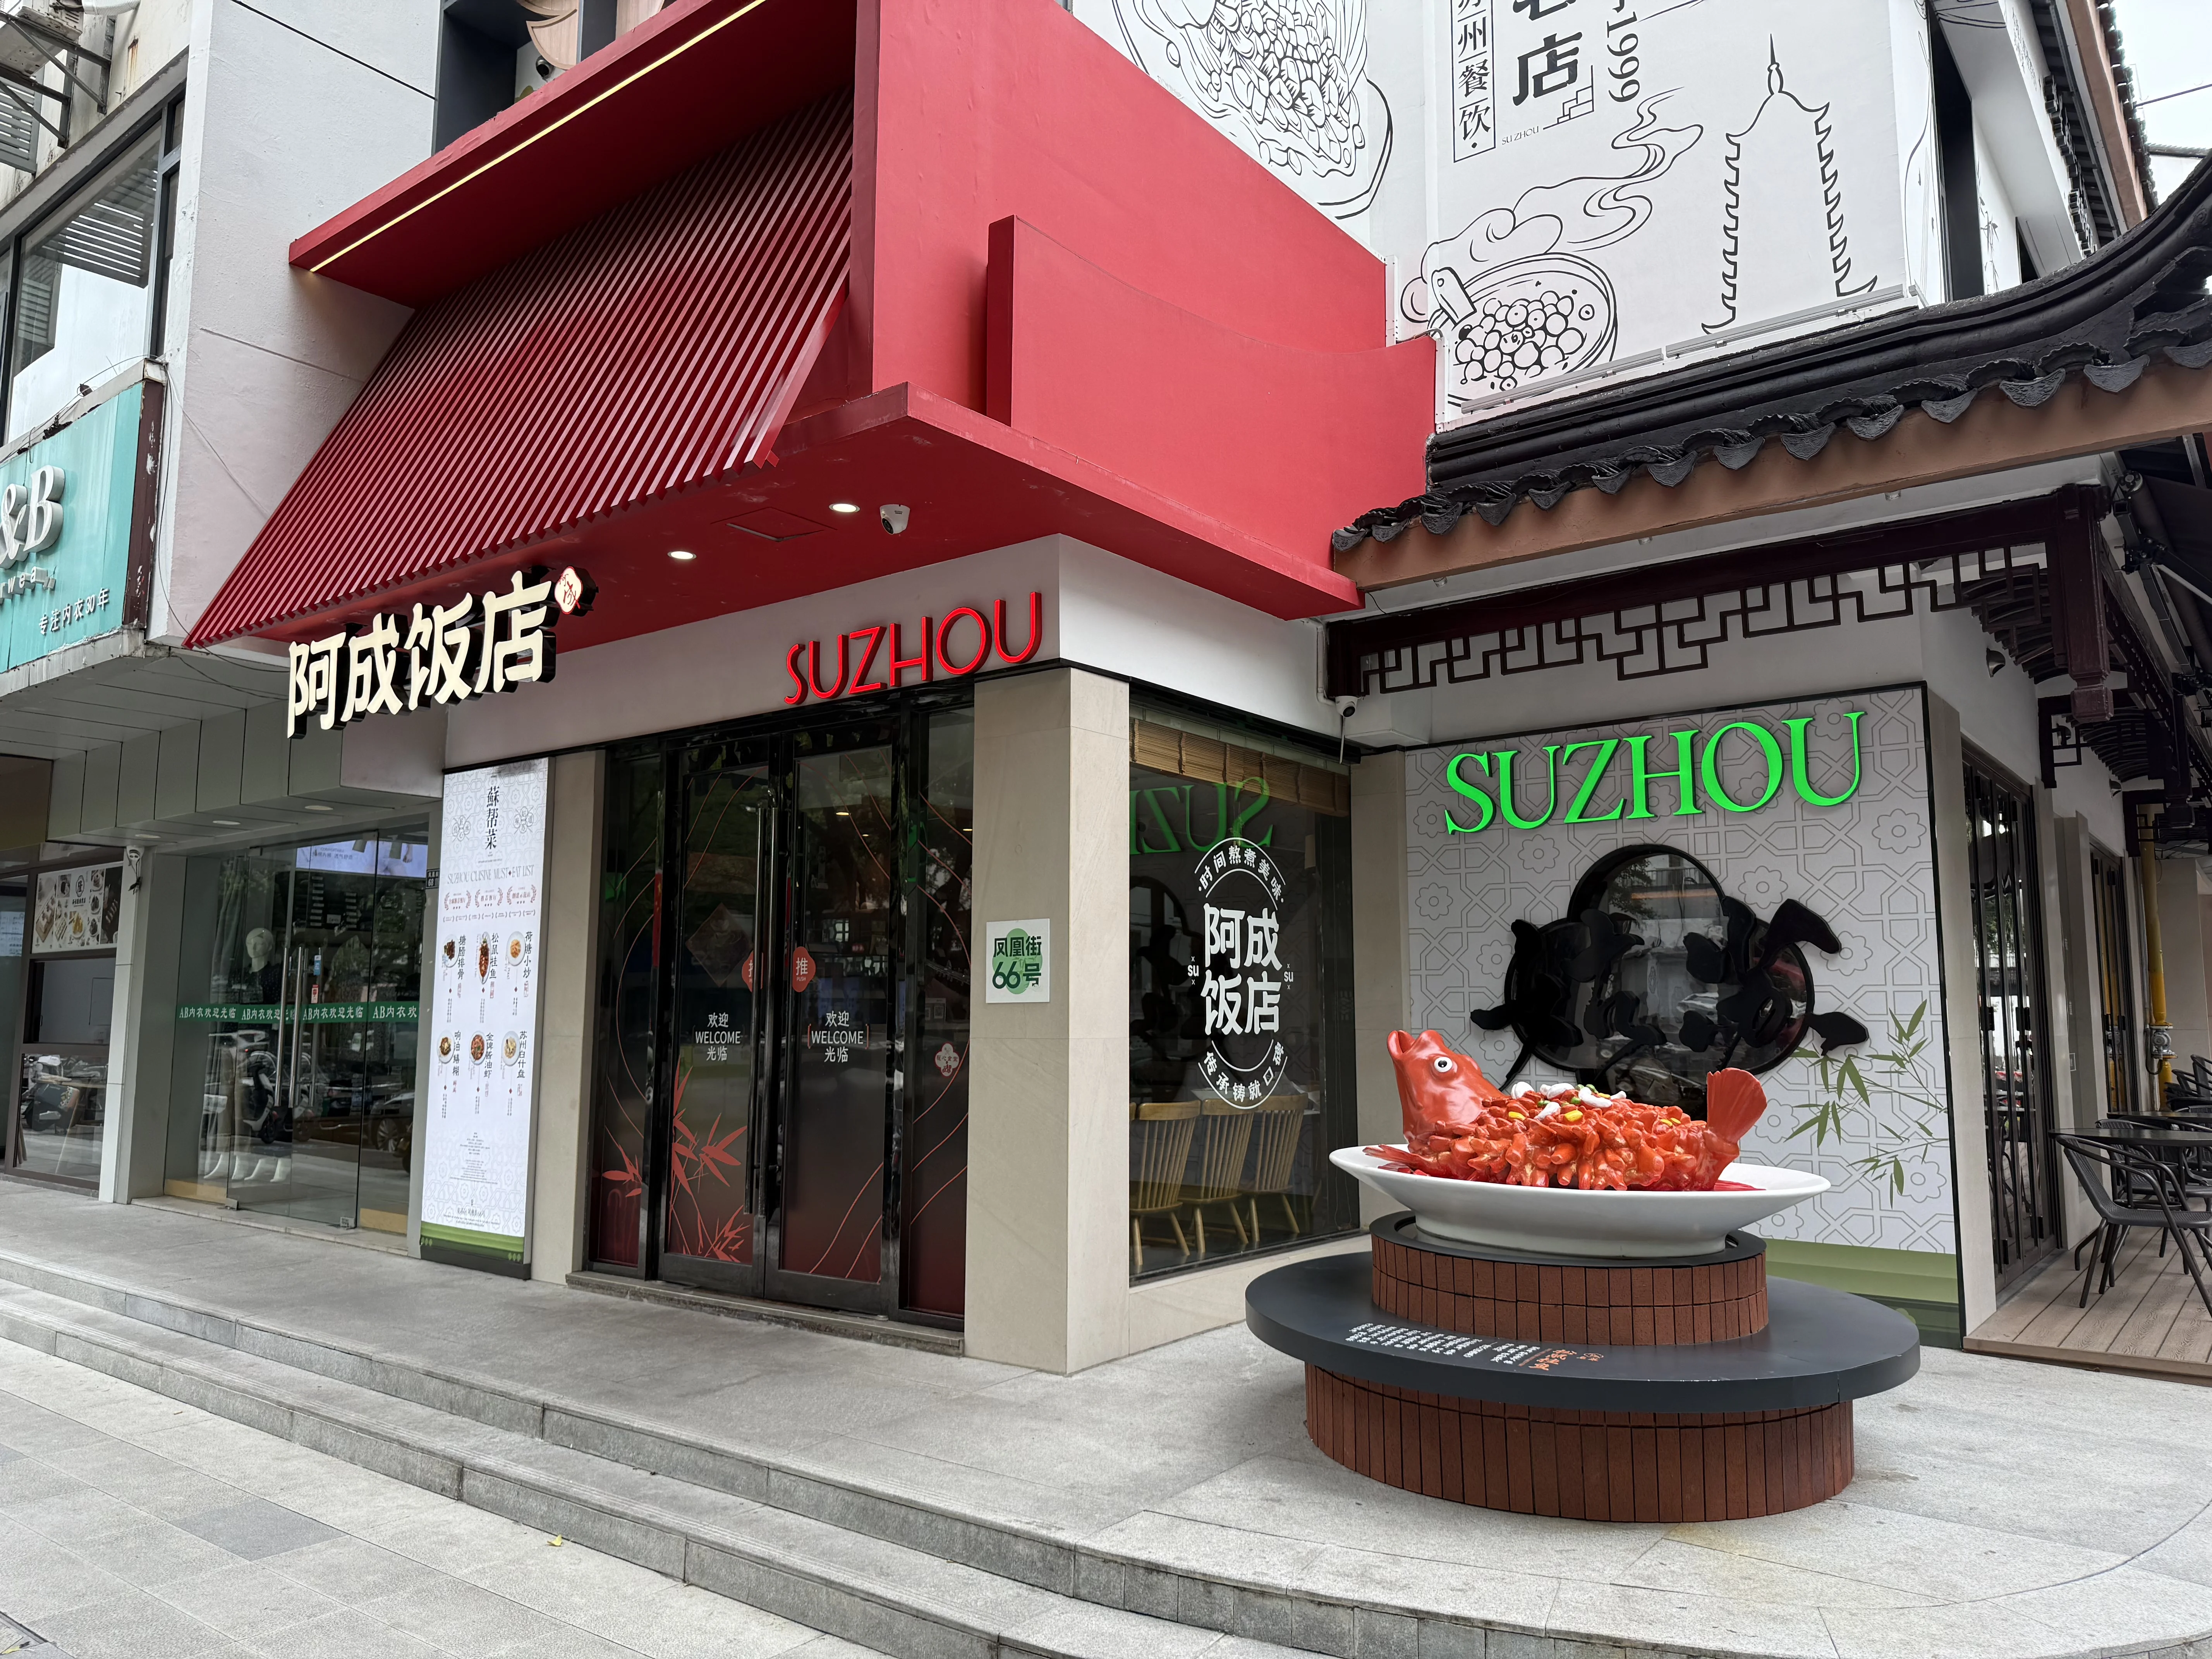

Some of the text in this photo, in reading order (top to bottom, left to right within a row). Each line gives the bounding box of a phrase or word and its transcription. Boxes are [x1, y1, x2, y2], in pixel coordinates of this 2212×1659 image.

[1512, 0, 1582, 106] 店
[1607, 0, 1640, 102] 1999
[1514, 126, 1539, 141] ZHOU
[39, 587, 110, 635] 专注内衣30年
[287, 570, 552, 739] 阿成饭店
[784, 592, 1042, 705] SUZHOU
[1445, 711, 1866, 835] SUZHOU
[471, 869, 492, 882] CUISINE
[493, 867, 509, 879] MUST
[522, 864, 534, 877] LIST
[1199, 845, 1282, 900] 时间熬煮美味
[993, 936, 1042, 958] 凤凰街
[1203, 903, 1282, 970] 阿成
[796, 957, 808, 975] 推
[992, 961, 1042, 989] 66号
[179, 1006, 236, 1019] AB内衣欢迎光临
[303, 1005, 364, 1021] AB内衣欢迎光临
[1200, 969, 1281, 1036] 饭店
[707, 1012, 729, 1028] 欢迎
[825, 1010, 850, 1027] 欢迎
[696, 1031, 741, 1044] WELCOME
[811, 1030, 864, 1044] WELCOME
[706, 1046, 728, 1061] 光临
[824, 1046, 849, 1063] 光临
[1204, 1041, 1285, 1103] 传承铸就口碑
